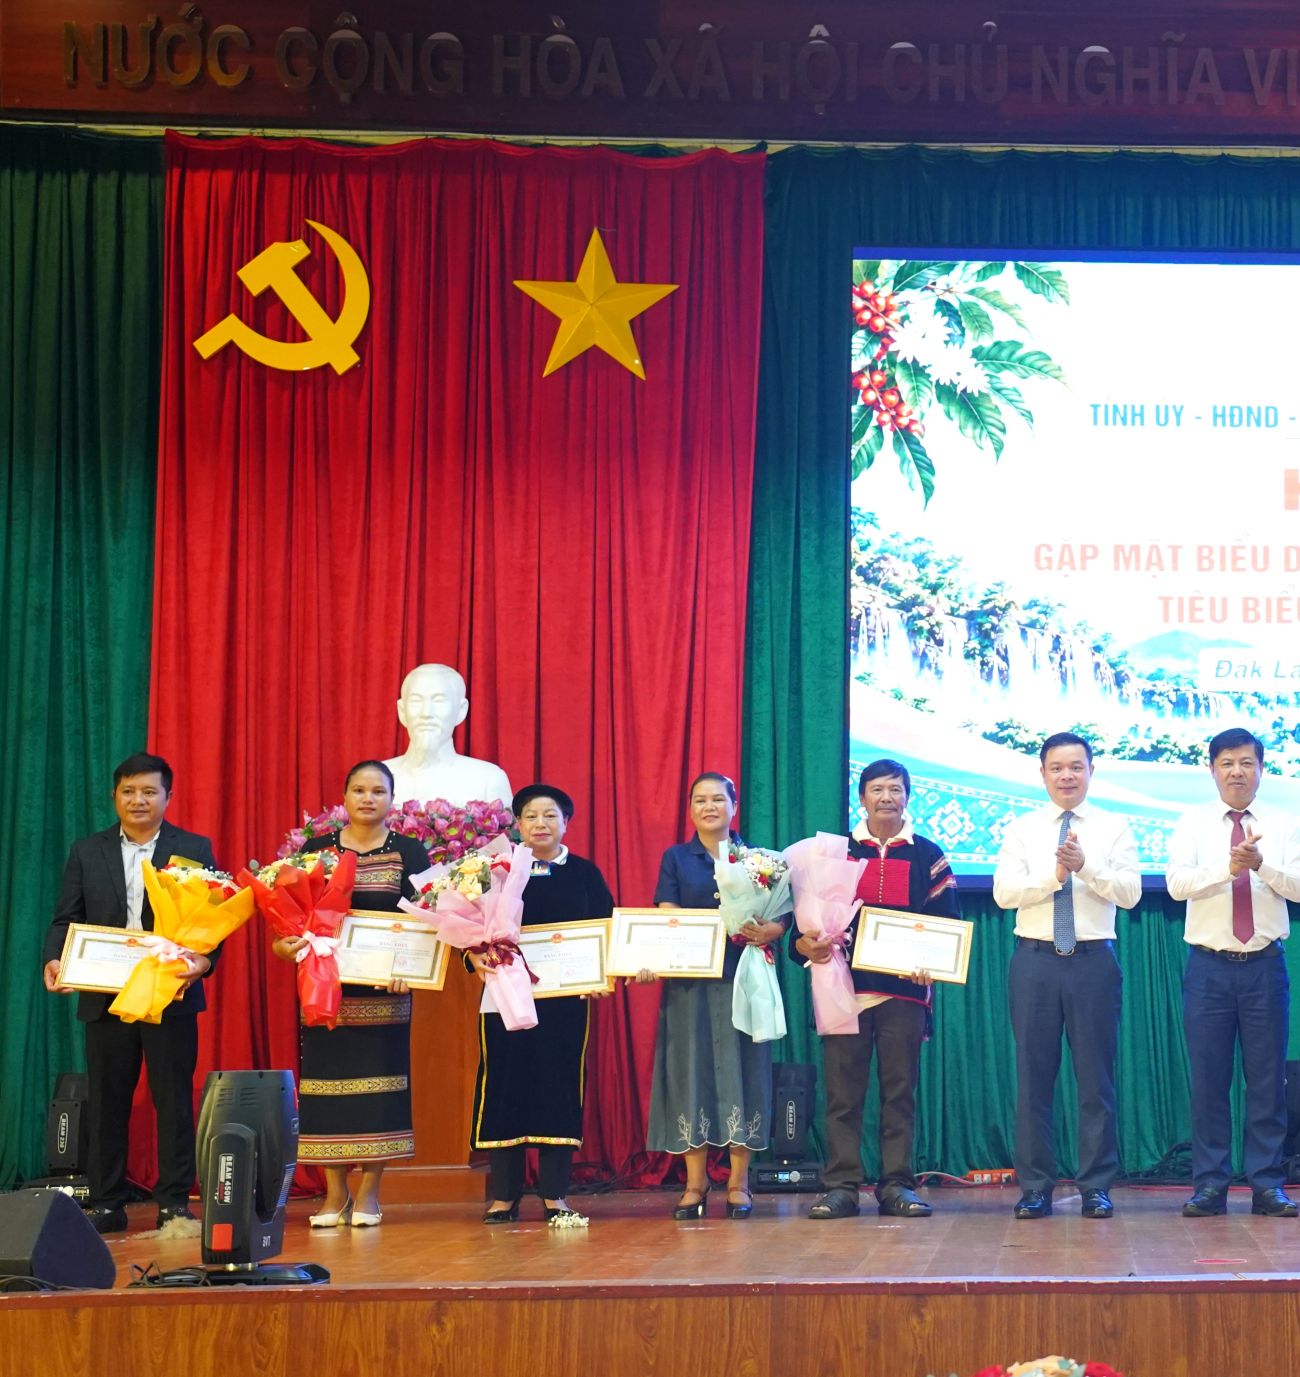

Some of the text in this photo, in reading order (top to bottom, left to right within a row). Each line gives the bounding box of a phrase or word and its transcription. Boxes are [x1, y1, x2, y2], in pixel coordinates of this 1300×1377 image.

[63, 3, 252, 90] NƯỚC
[275, 12, 464, 103] CỘNG
[493, 15, 625, 98] HÒA
[752, 23, 859, 115] HỘI
[882, 21, 1009, 105] CHỦ
[1031, 31, 1240, 106] NGHĨA
[1212, 405, 1279, 428] HĐND
[223, 1155, 233, 1203] BEAM 450W
